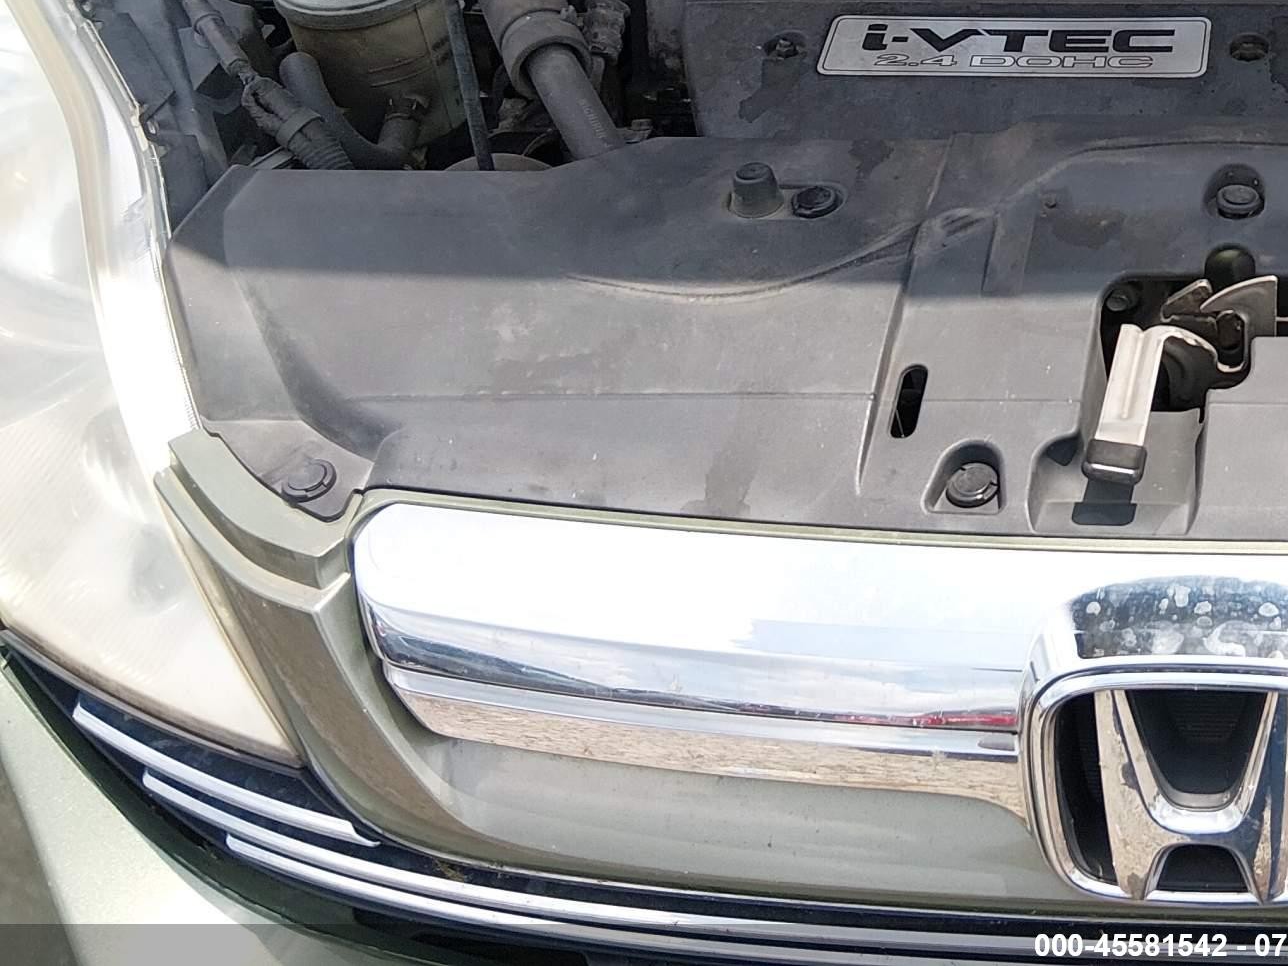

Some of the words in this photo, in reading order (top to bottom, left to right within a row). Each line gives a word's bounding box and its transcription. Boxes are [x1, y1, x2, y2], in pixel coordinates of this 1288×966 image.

[861, 23, 1176, 54] i-VTEC
[873, 53, 958, 68] 2.4
[969, 54, 1155, 69] DOHC
